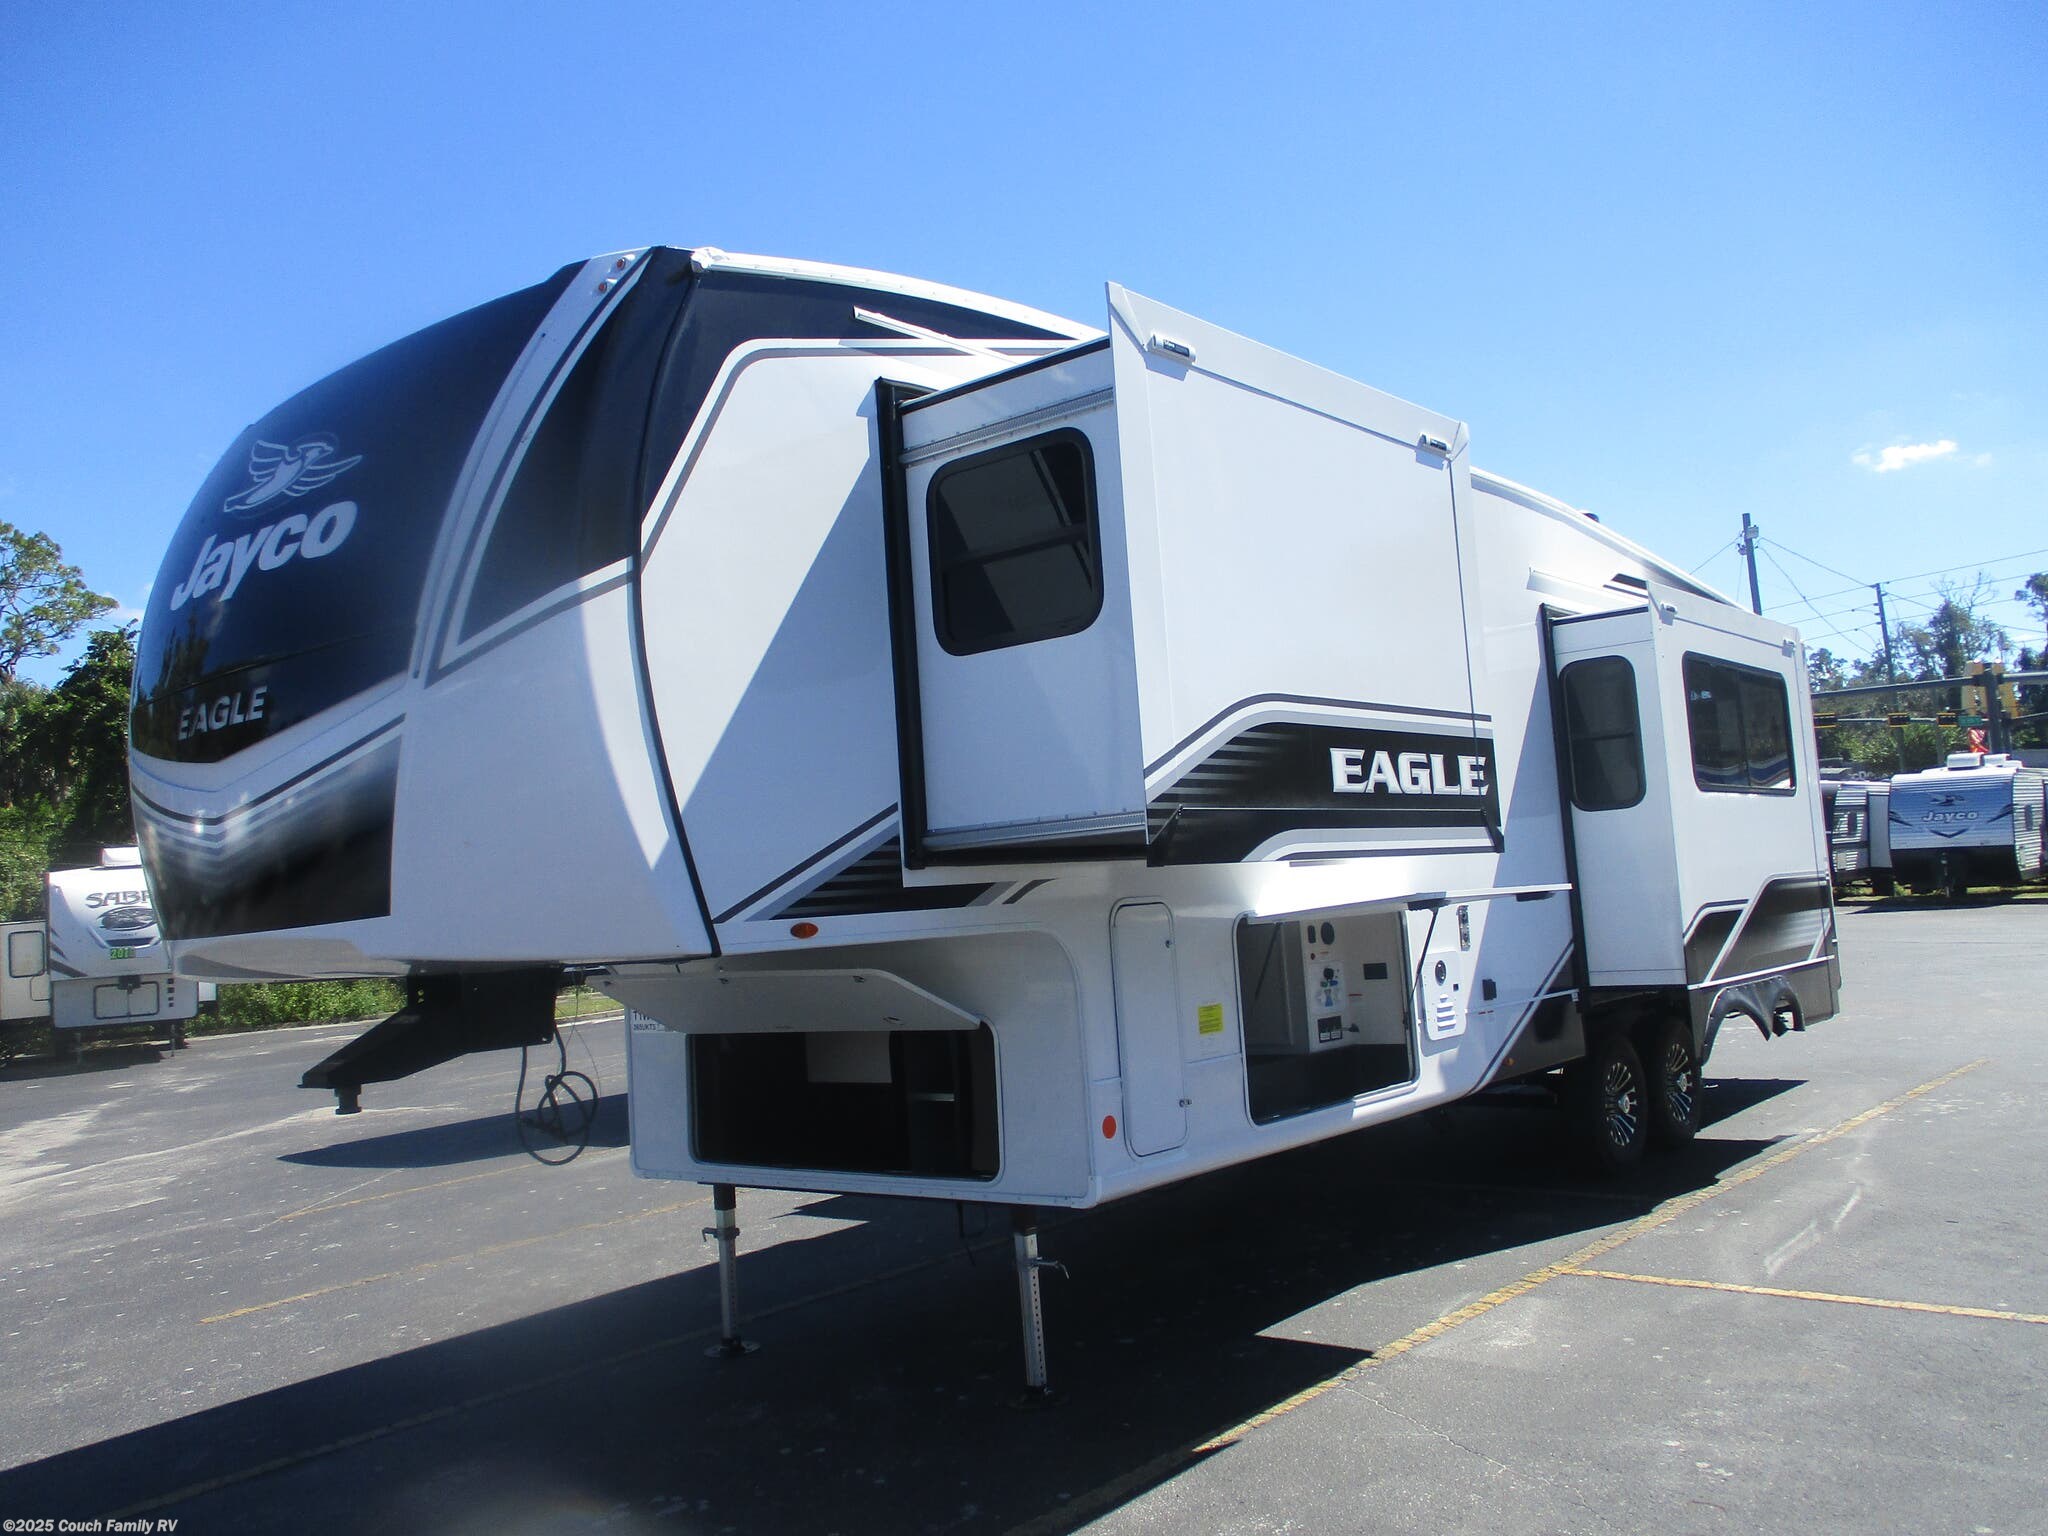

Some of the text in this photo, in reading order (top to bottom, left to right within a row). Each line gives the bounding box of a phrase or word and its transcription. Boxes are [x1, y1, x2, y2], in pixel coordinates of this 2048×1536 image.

[170, 500, 358, 611] Jayco
[178, 685, 268, 741] EAGLE
[1330, 747, 1489, 796] EAGLE
[1922, 810, 1978, 823] Jayco
[85, 890, 151, 909] SAB
